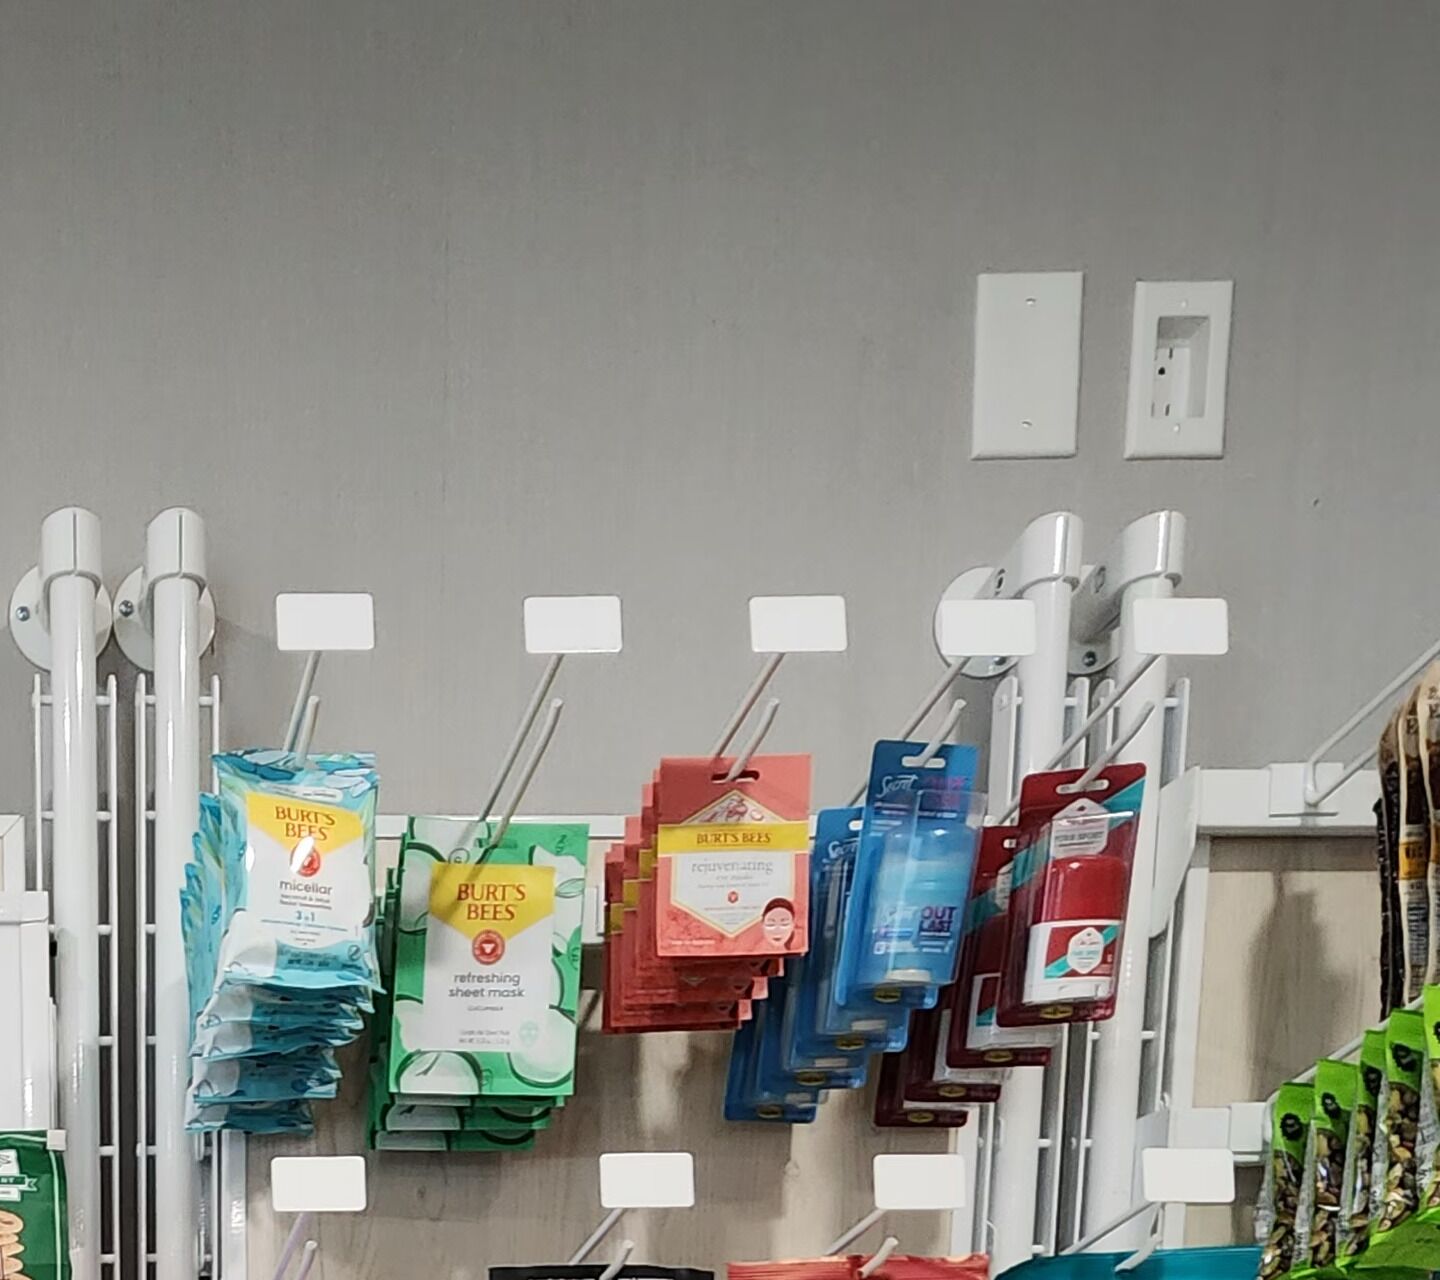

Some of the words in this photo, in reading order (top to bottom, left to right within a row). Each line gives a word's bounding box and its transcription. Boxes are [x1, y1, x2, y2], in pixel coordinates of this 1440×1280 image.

[275, 806, 335, 826] BURT'S
[285, 823, 330, 841] BEES
[696, 832, 739, 844] BURT'S
[742, 832, 772, 843] BEES
[691, 858, 774, 875] rejuvenating
[279, 880, 333, 896] micellar
[457, 883, 527, 902] BURT'S
[466, 903, 516, 921] BEES
[921, 906, 957, 919] OUT
[454, 972, 521, 988] refreshing
[448, 986, 484, 999] sheet
[488, 985, 525, 998] mask
